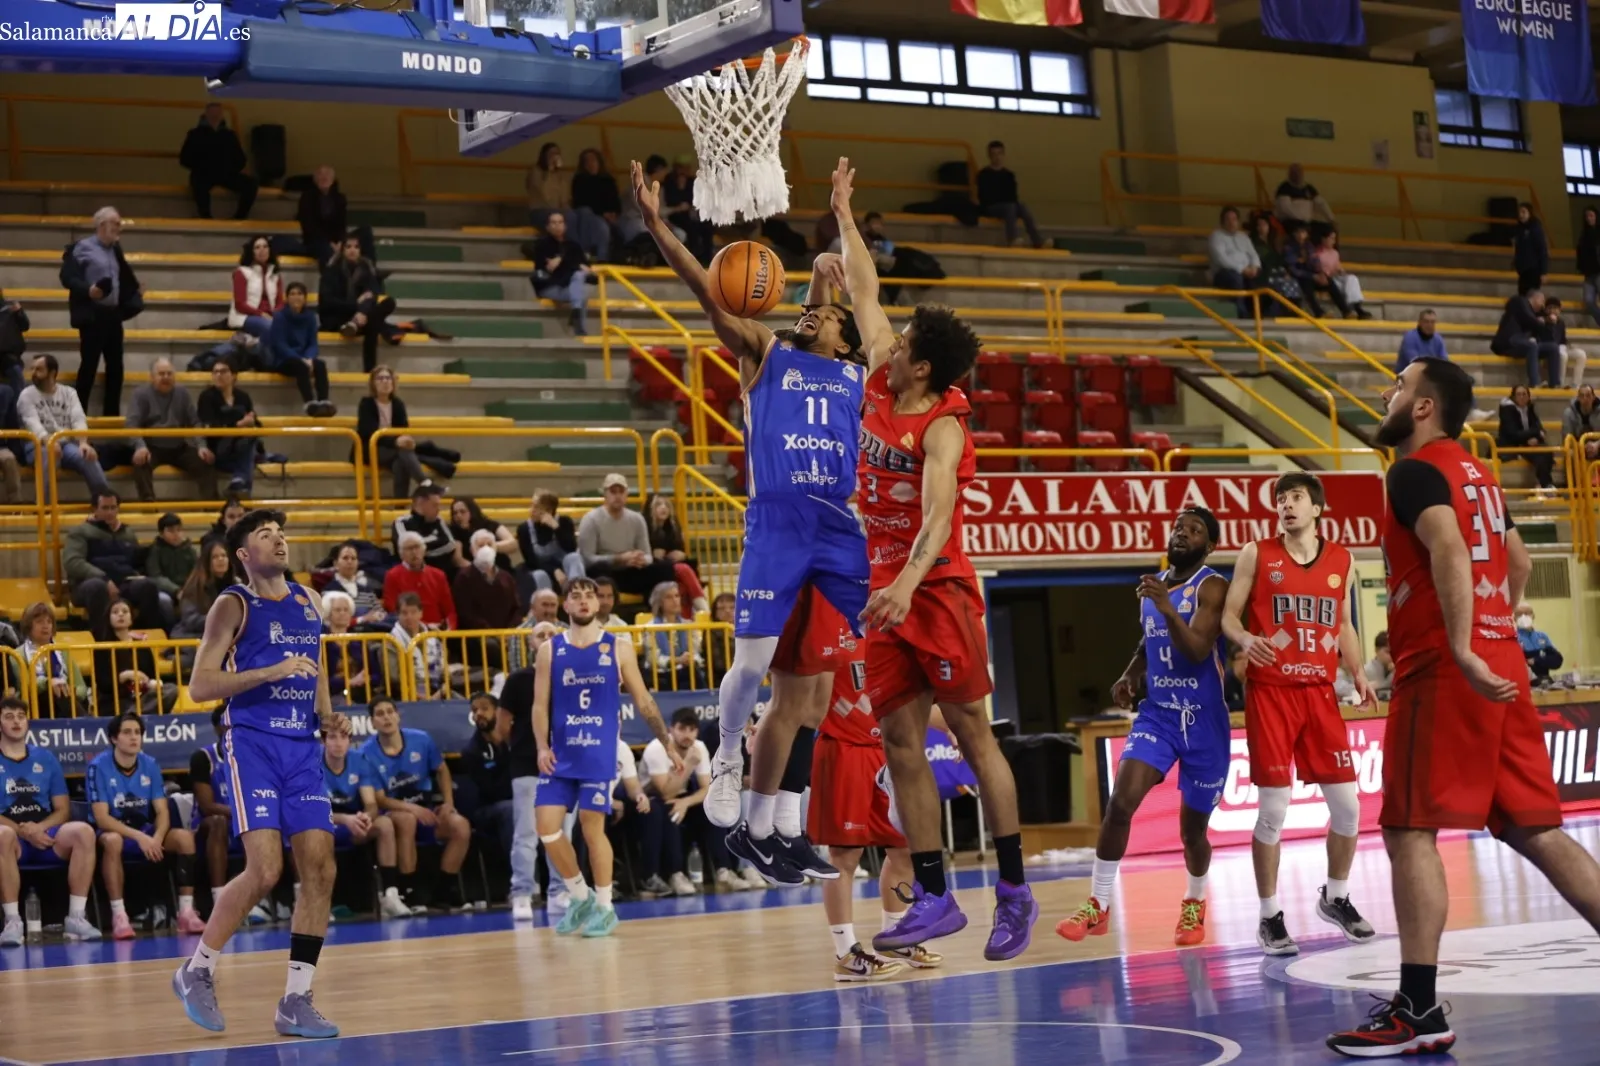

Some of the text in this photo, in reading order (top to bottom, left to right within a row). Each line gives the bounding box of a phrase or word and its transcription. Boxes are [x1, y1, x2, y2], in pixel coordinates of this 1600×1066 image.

[1475, 0, 1573, 21] EUROEAGUE
[402, 51, 482, 75] MONDO
[751, 250, 769, 300] Wilson
[804, 396, 828, 425] 11
[782, 433, 845, 457] Xoborg
[866, 472, 879, 503] 3
[961, 478, 1332, 517] SALAMANC
[1462, 484, 1507, 562] 34
[962, 521, 1101, 553] RIMONIO
[1110, 521, 1154, 550] DE
[1272, 594, 1337, 629] PBB
[1296, 627, 1316, 653] 15
[939, 659, 952, 681] 3
[1159, 645, 1174, 670] 4
[579, 689, 591, 710] 6
[25, 718, 197, 747] ASTILLA LEÓN
[1333, 750, 1351, 768] 15
